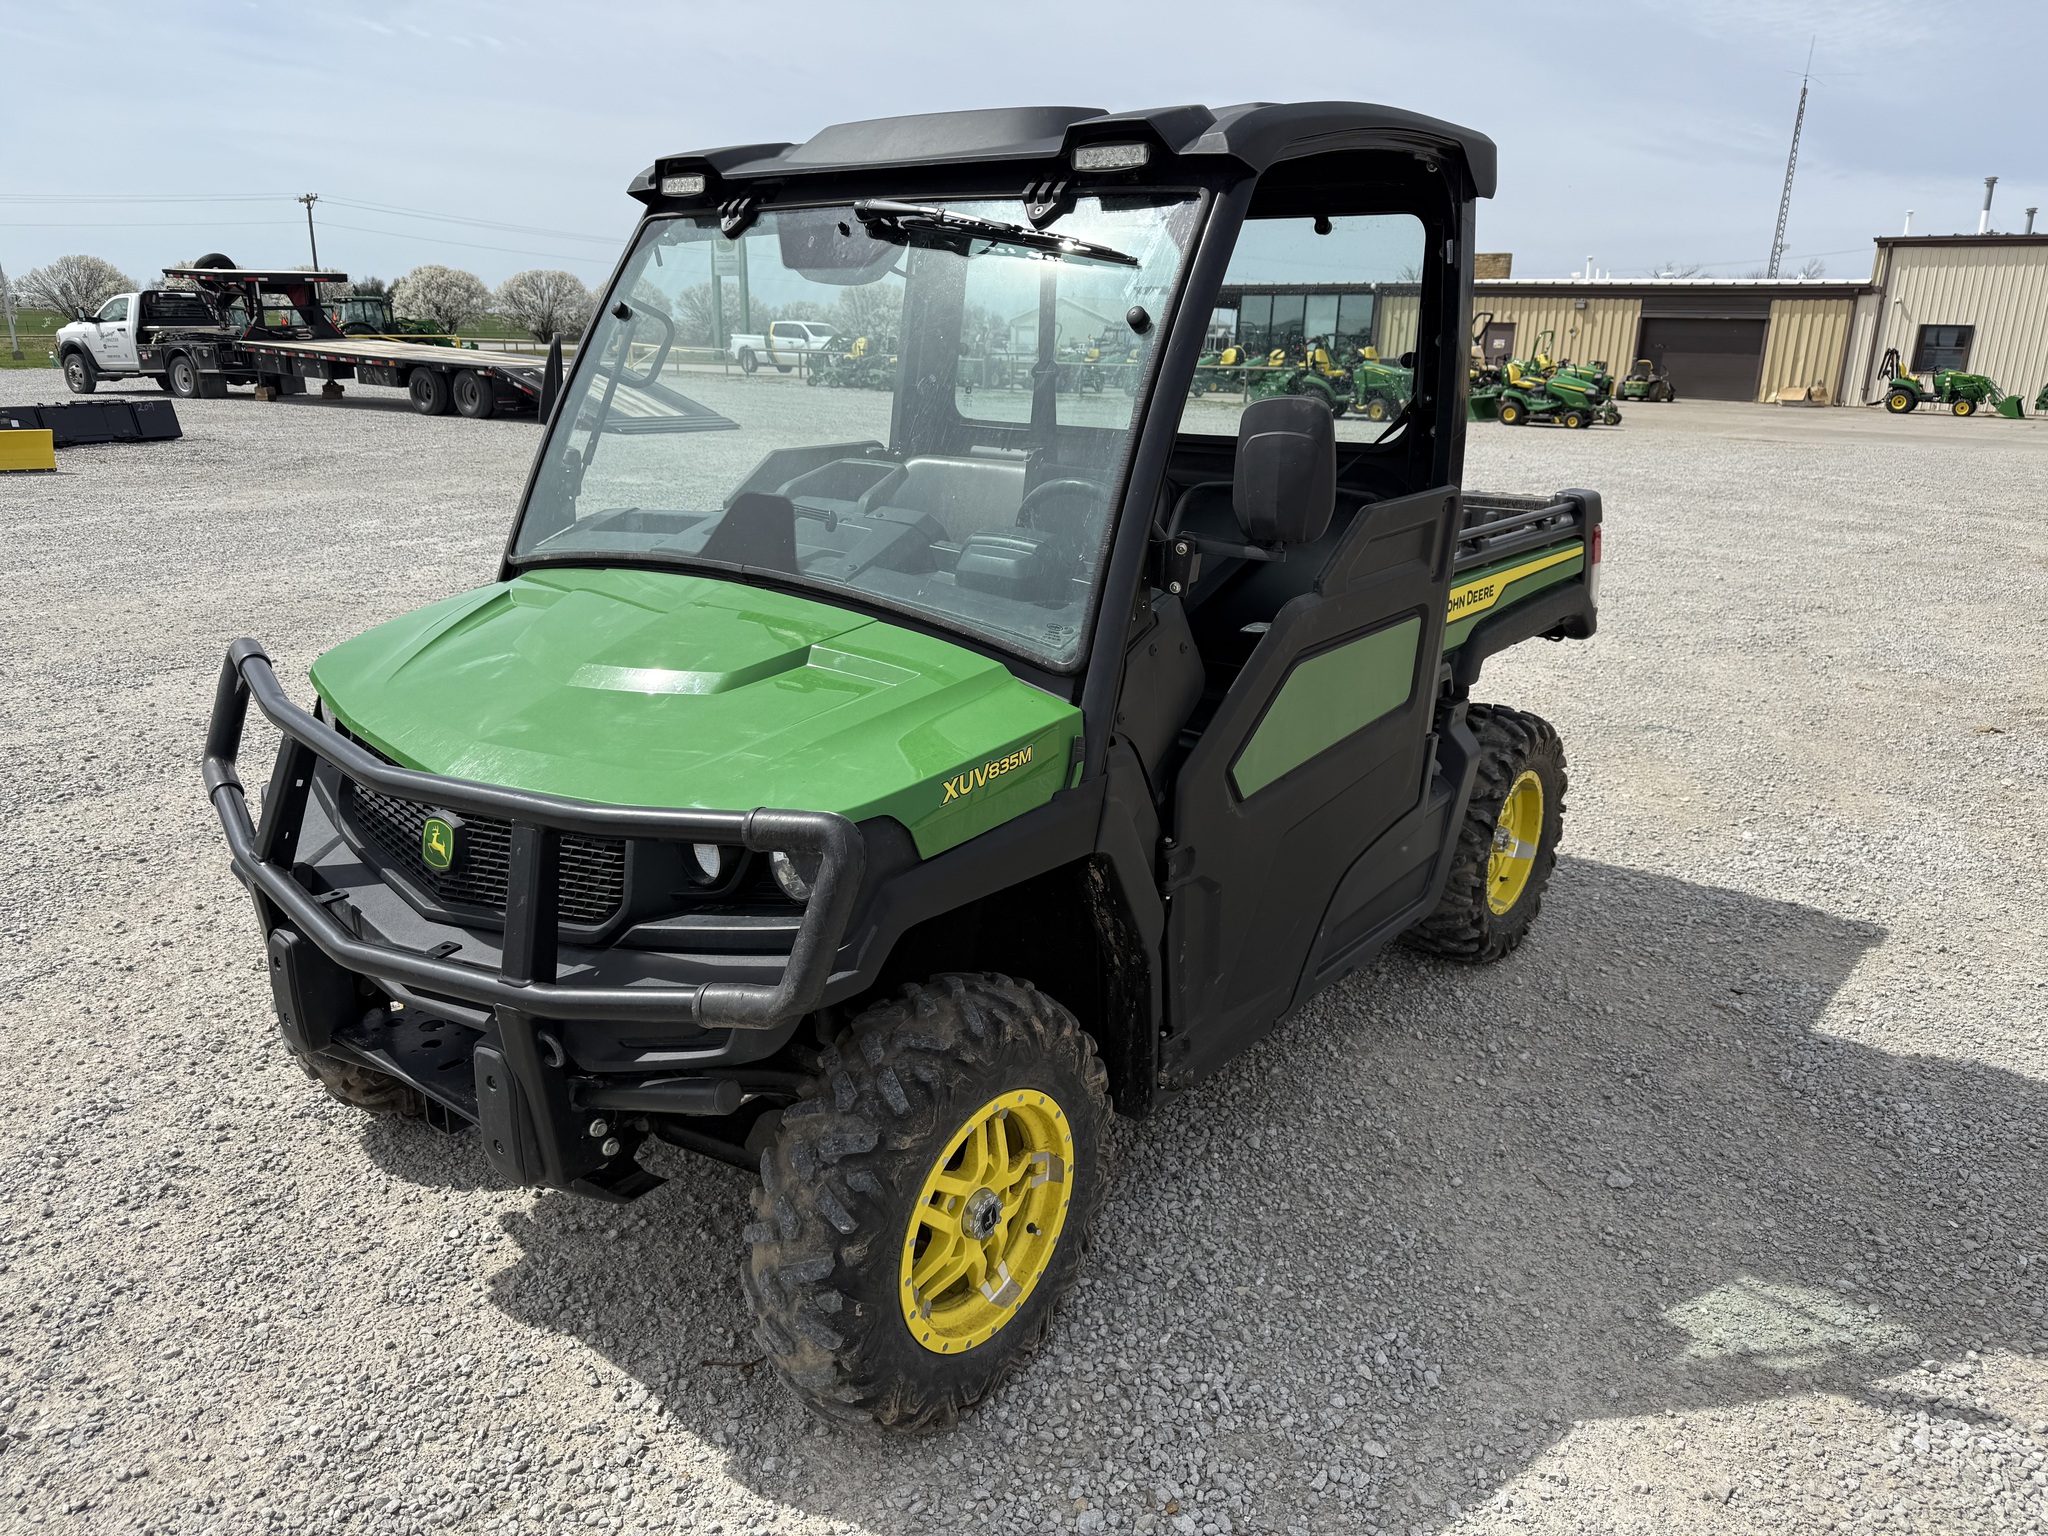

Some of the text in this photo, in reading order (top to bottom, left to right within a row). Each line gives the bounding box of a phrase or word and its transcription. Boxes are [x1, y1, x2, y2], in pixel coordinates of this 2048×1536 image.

[136, 402, 155, 411] 209
[1447, 584, 1495, 613] OHN DEERE
[941, 745, 1032, 806] XUV835M
